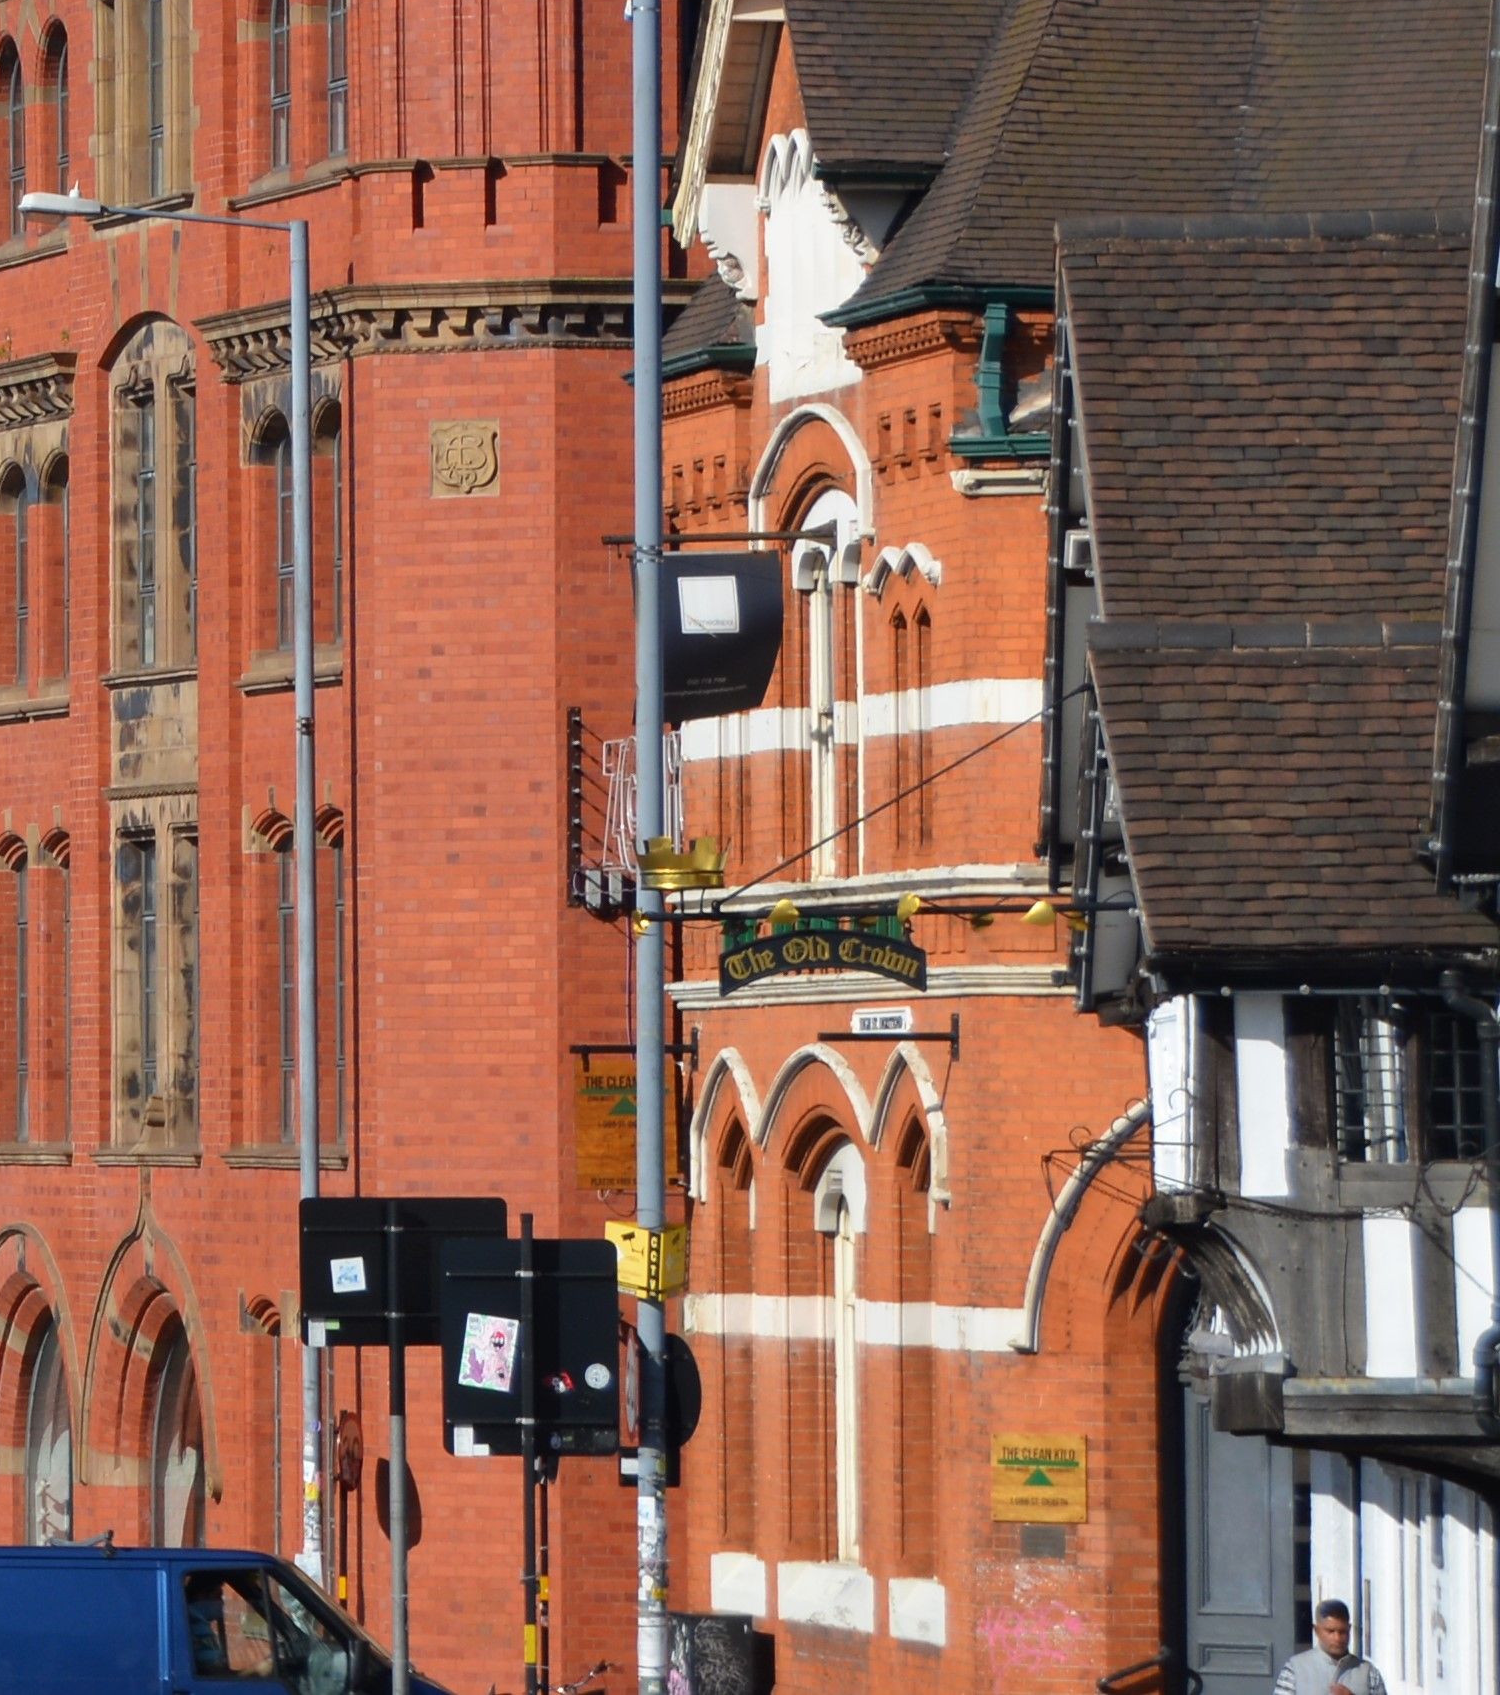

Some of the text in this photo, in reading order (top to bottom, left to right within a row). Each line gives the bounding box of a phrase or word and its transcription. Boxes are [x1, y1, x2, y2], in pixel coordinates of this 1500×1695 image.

[725, 935, 921, 981] The Old Crown
[585, 1076, 605, 1090] THE
[650, 1235, 659, 1291] CCTV
[1002, 1447, 1076, 1461] THE CLEAN KILO
